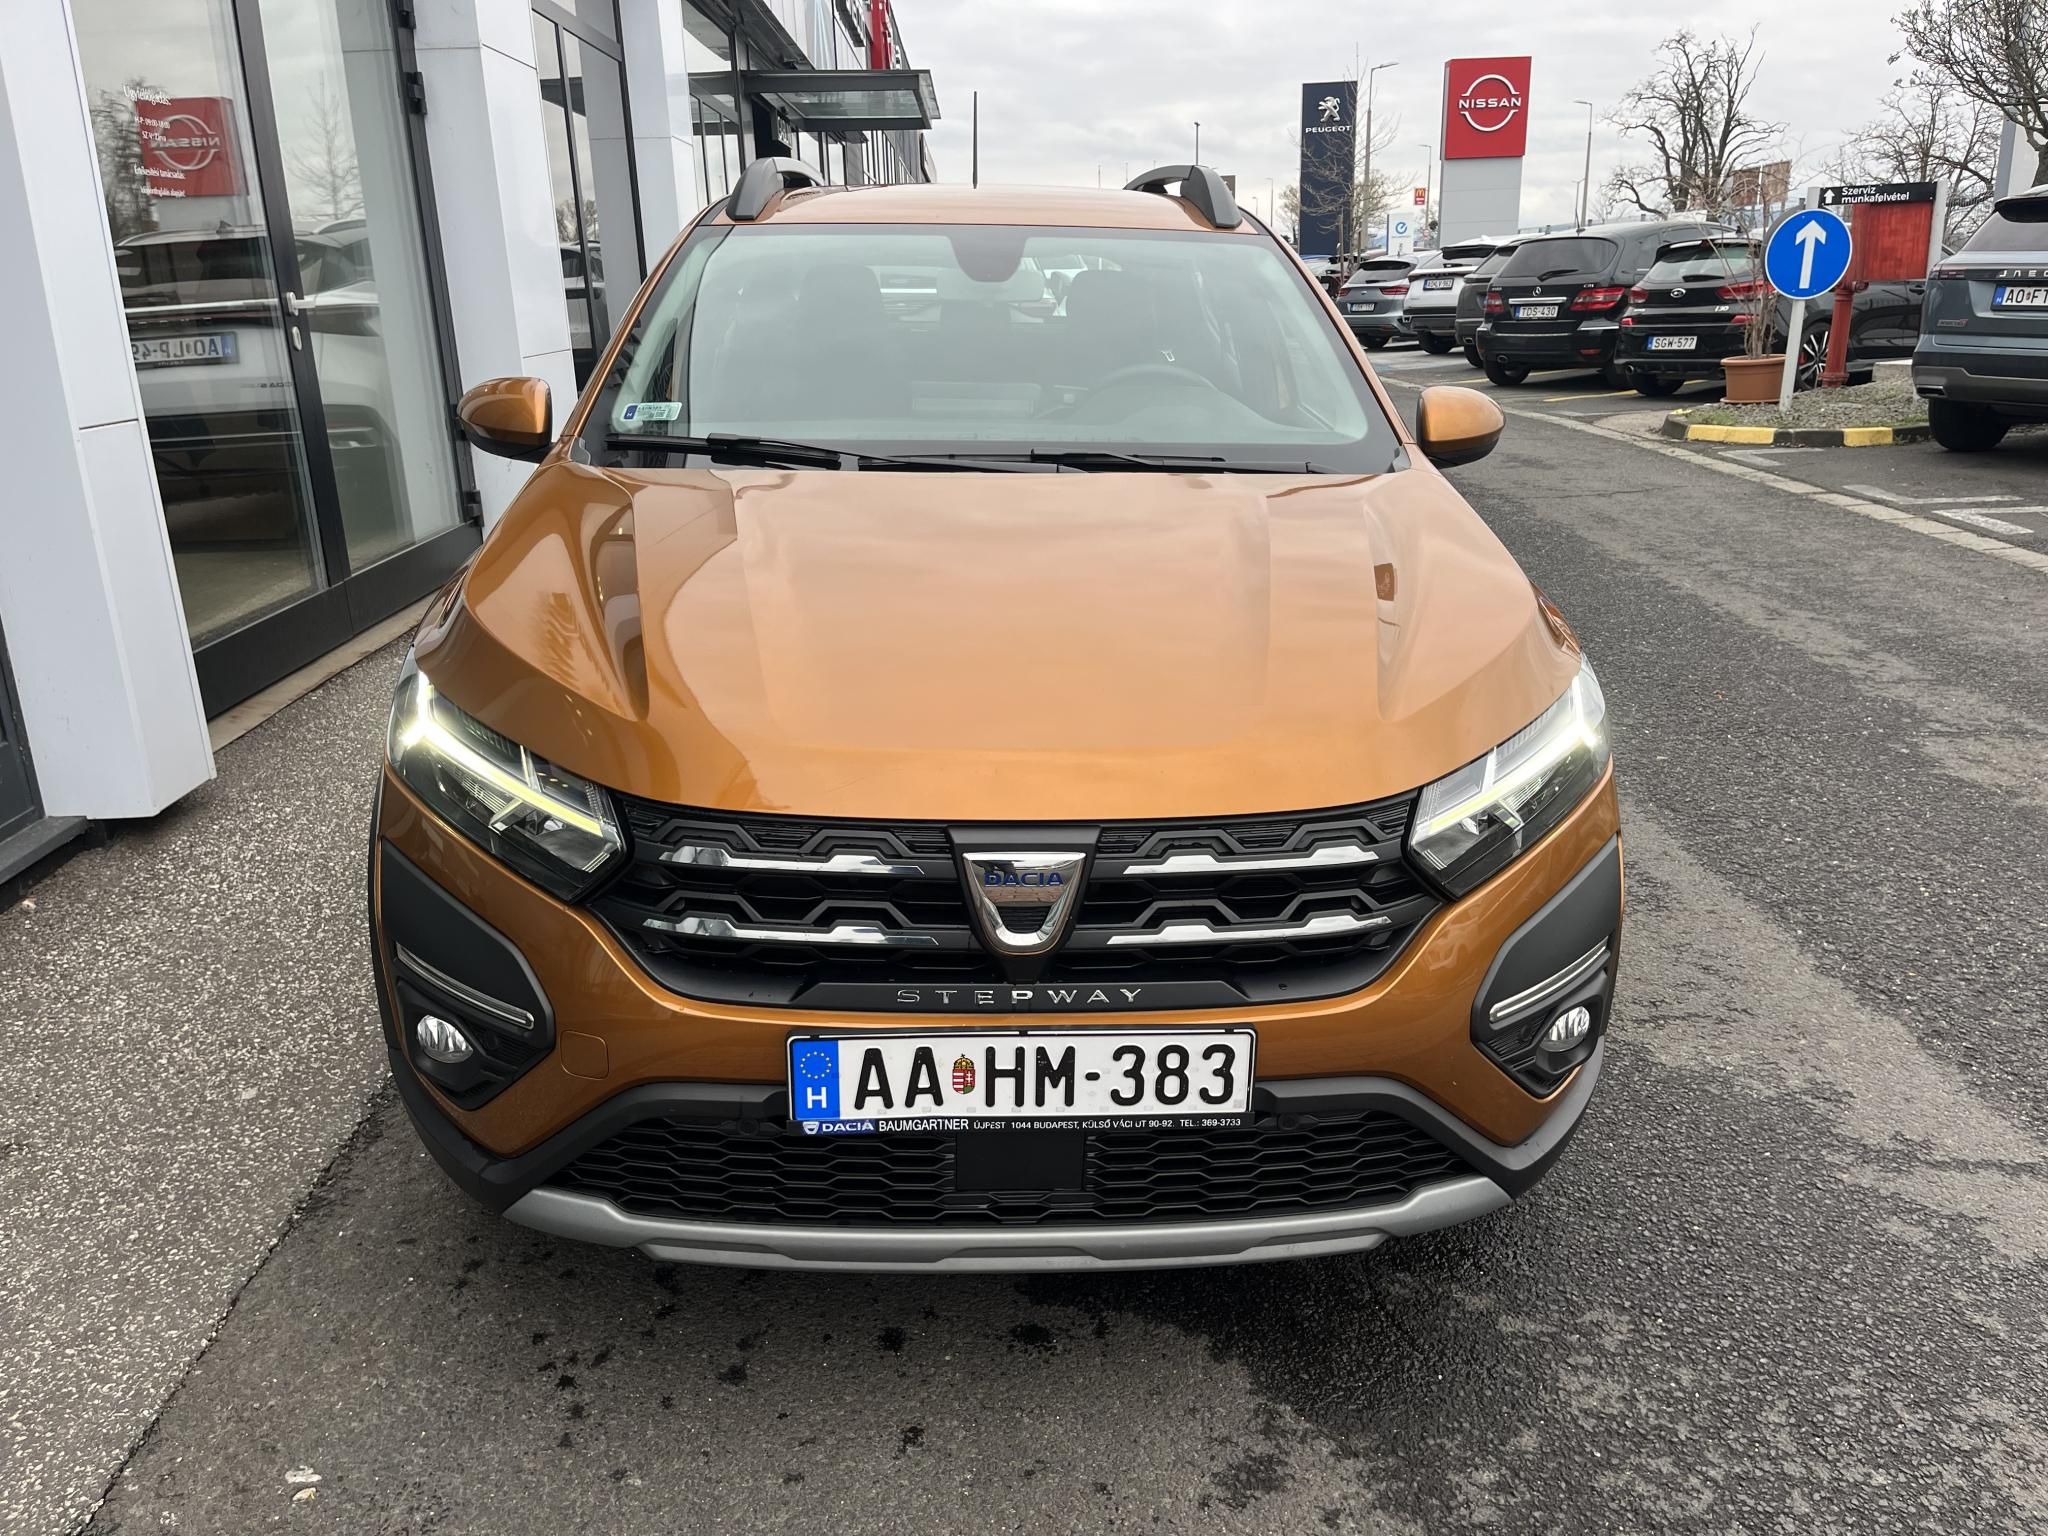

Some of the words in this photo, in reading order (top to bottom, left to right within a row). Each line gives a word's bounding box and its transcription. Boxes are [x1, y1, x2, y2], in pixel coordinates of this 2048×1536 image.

[1459, 97, 1521, 109] NISSAN
[1305, 125, 1351, 133] PEUGEOT
[1842, 185, 1877, 196] Szerviz
[1841, 191, 1910, 204] munkafelvétel
[1654, 338, 1695, 348] SGW-577
[984, 872, 1064, 887] DACIA
[897, 988, 1142, 1005] STEPWAY
[806, 1086, 828, 1109] H
[822, 1119, 874, 1132] DACIA
[878, 1118, 969, 1132] BAUMGARTNER
[974, 1120, 1006, 1129] ÚJPEST
[1011, 1121, 1032, 1129] 1044
[1034, 1120, 1080, 1130] BUDAPEST,
[1113, 1119, 1133, 1128] VÁCI
[1201, 1118, 1241, 1127] 369-3733
